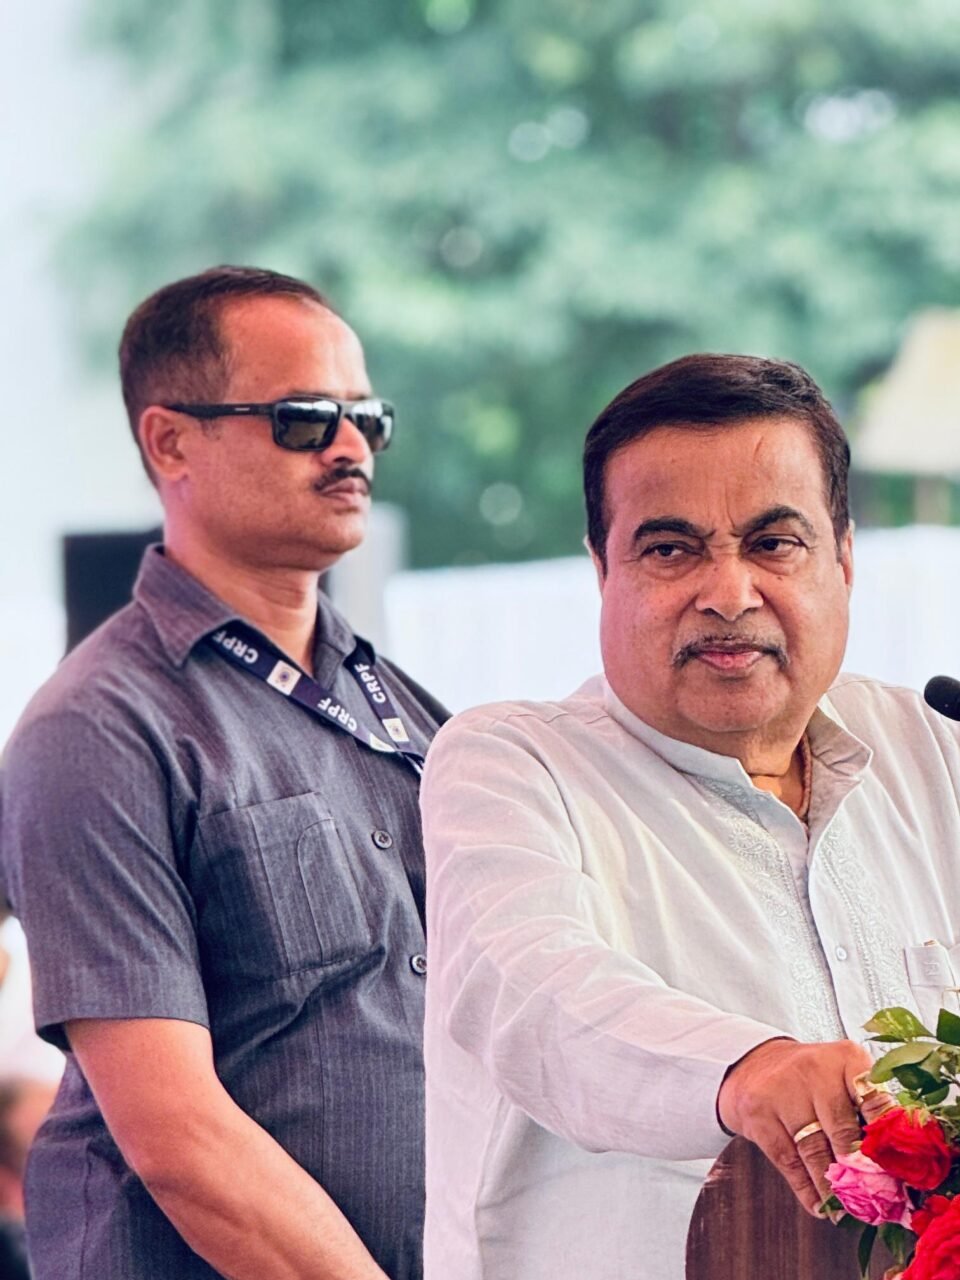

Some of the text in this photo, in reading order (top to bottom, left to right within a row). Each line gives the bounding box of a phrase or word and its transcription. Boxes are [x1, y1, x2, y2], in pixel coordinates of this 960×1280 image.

[212, 631, 259, 664] CRPF
[354, 663, 386, 704] CRPF
[317, 697, 357, 732] CRPF
